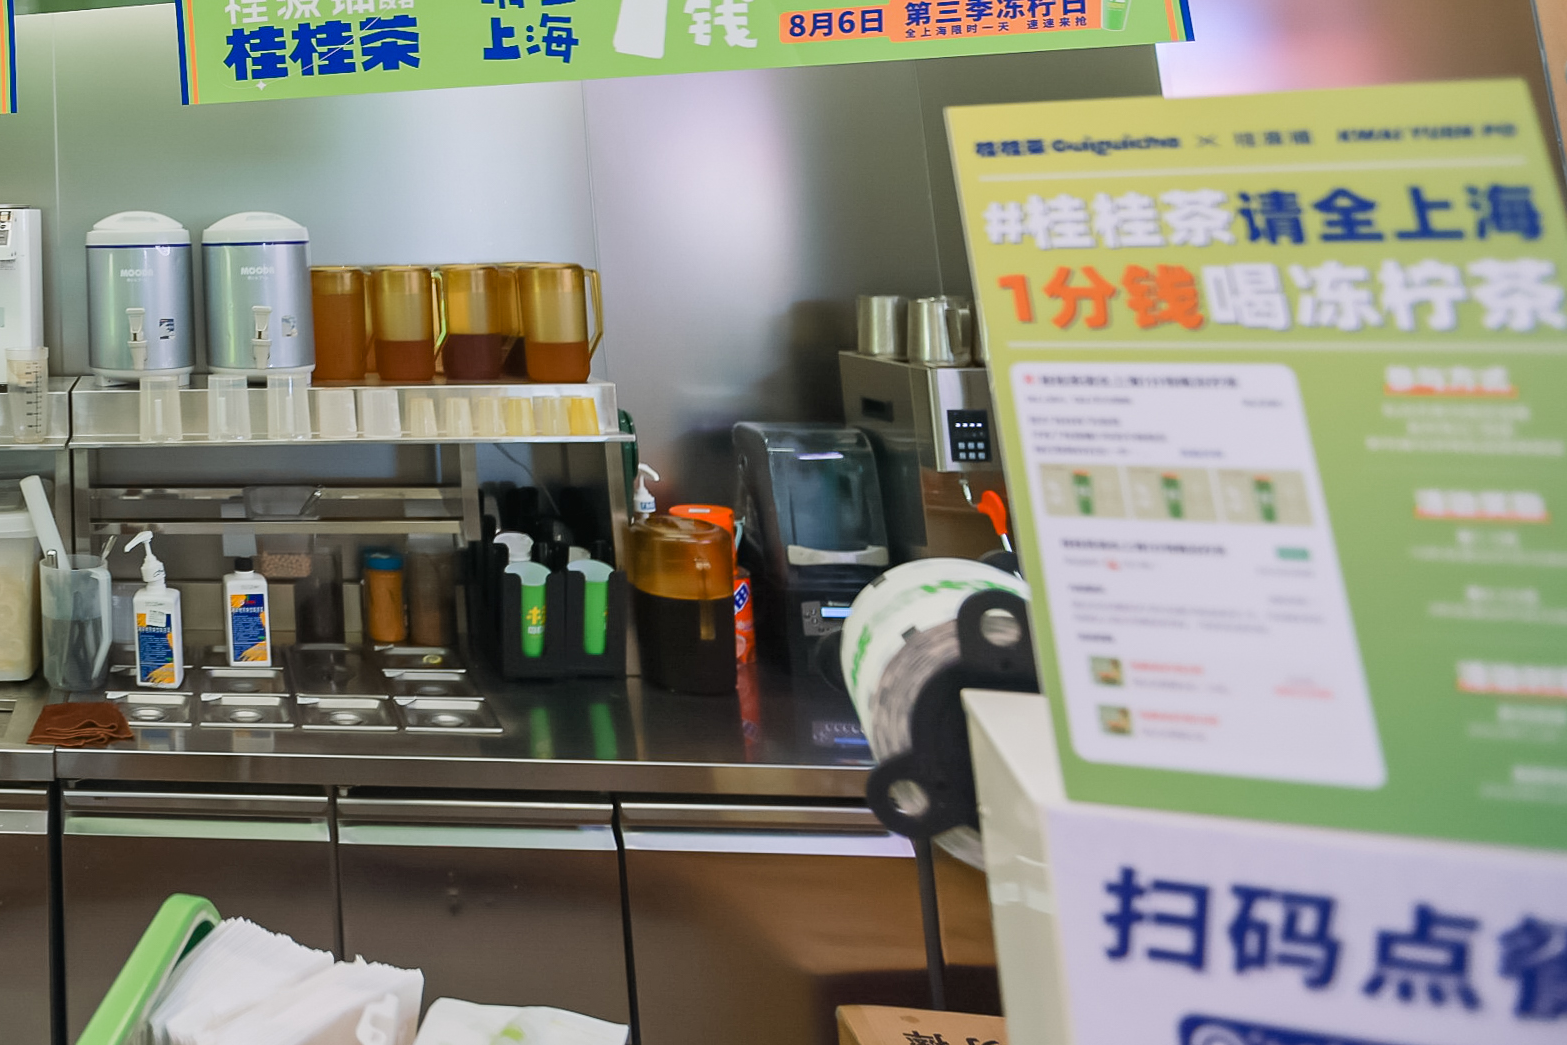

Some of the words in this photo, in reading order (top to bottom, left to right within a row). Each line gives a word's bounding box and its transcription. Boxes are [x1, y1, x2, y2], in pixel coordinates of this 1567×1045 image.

[224, 14, 421, 82] 桂桂茶
[483, 12, 580, 64] 上海
[789, 7, 885, 38] 8月6日
